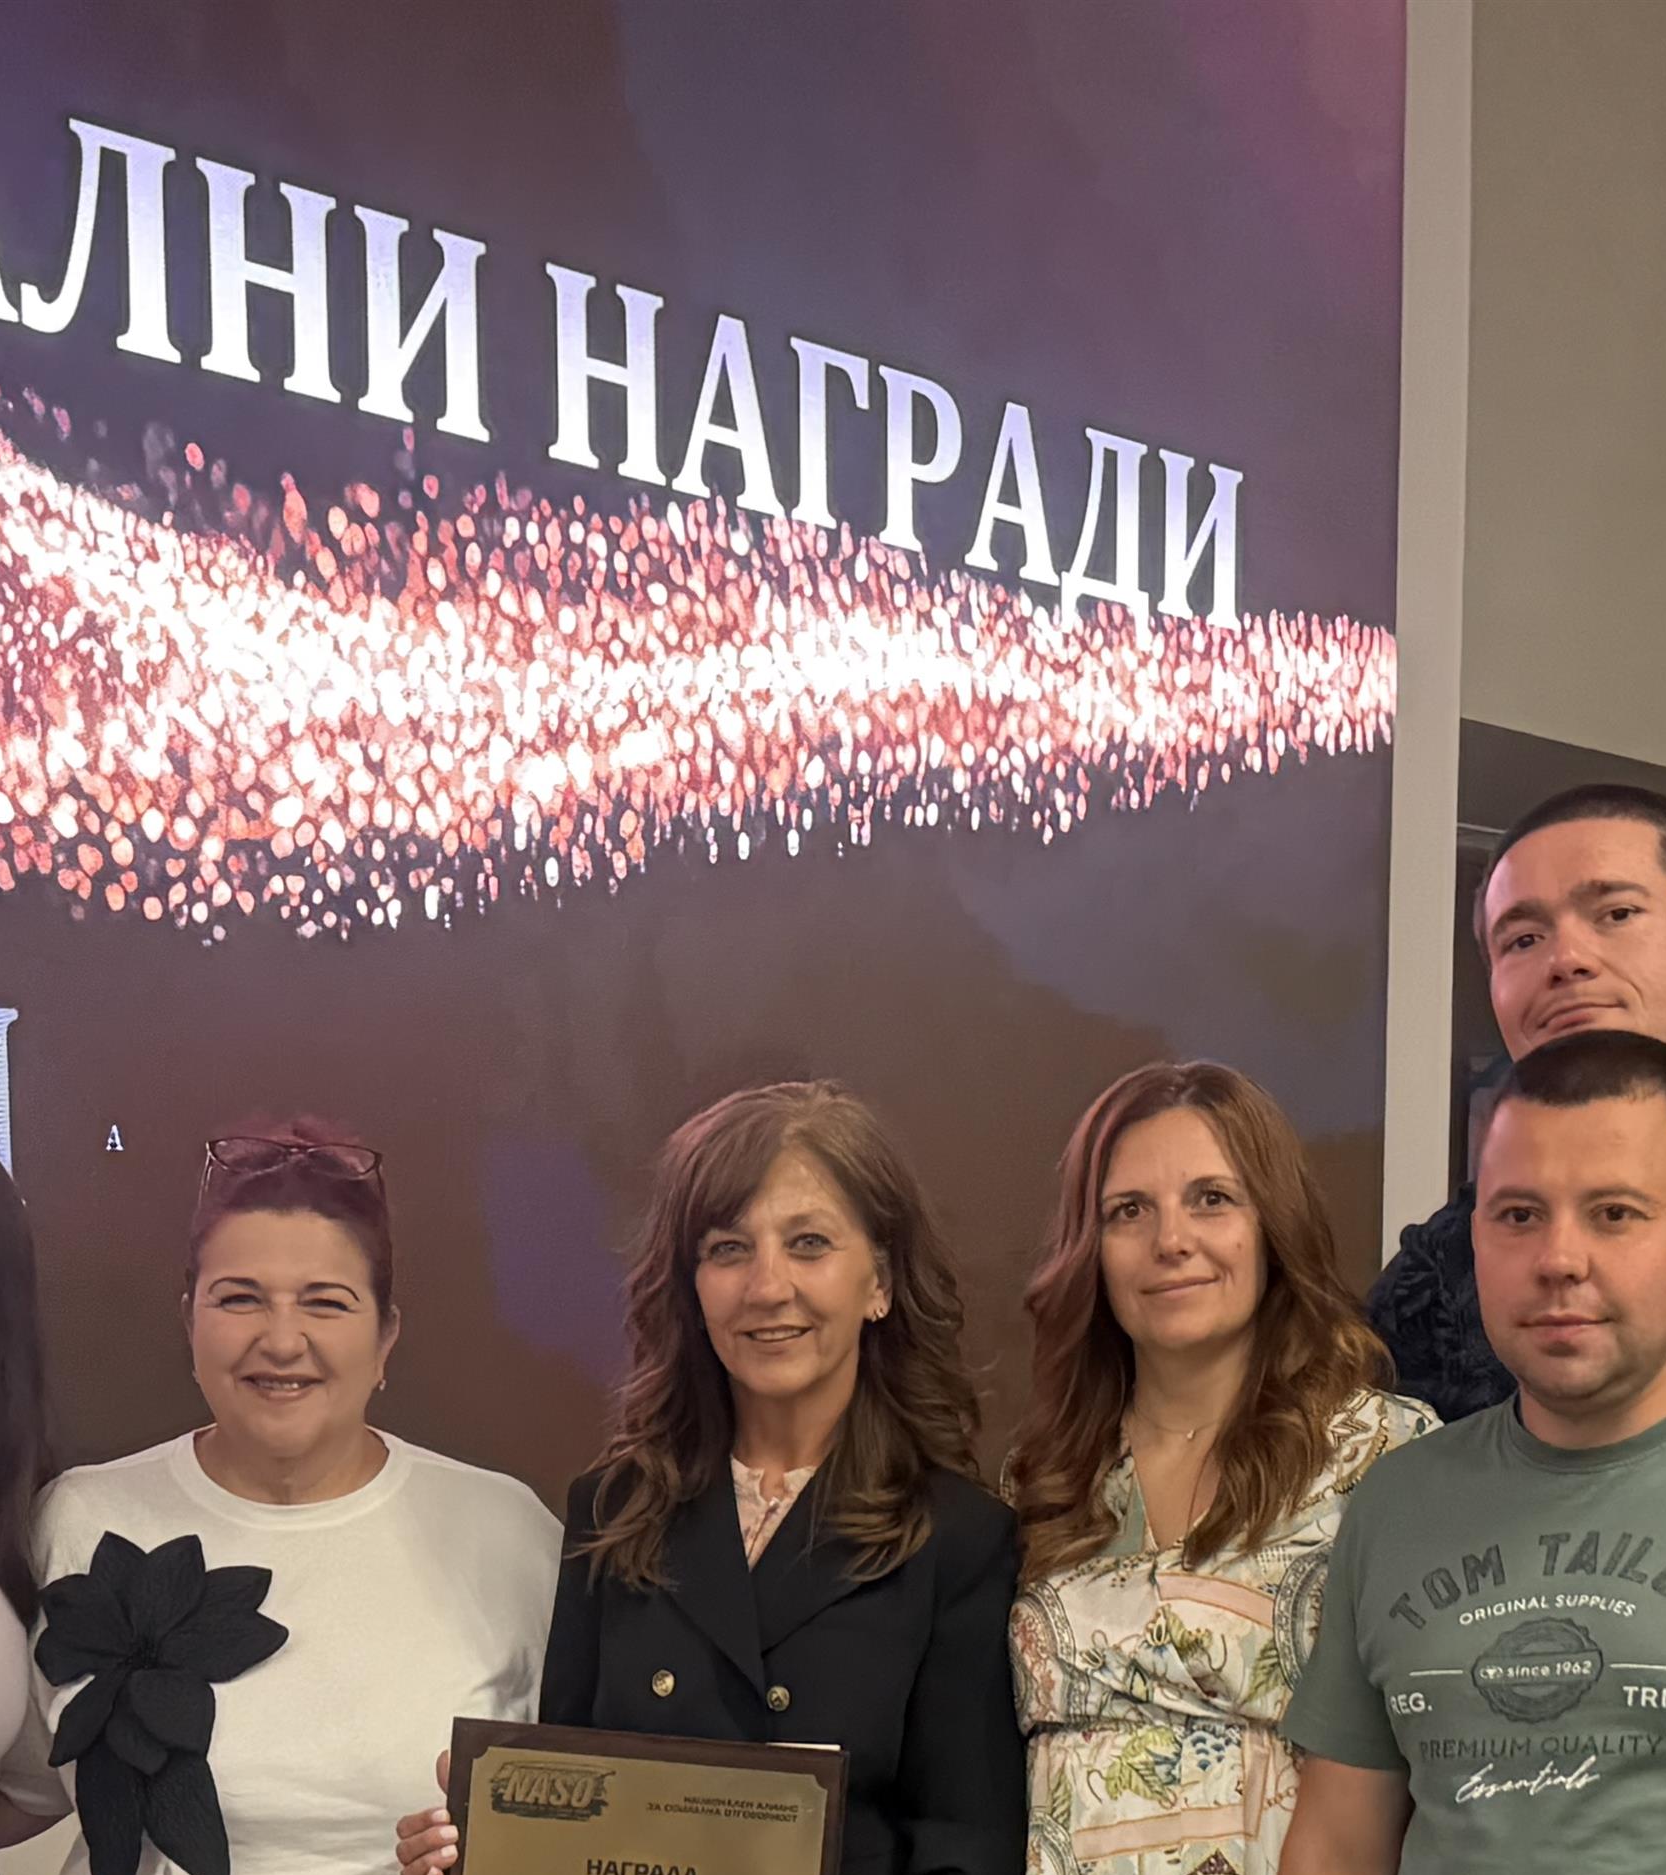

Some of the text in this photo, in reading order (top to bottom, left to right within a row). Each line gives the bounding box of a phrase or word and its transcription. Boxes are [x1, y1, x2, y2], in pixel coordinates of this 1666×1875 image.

[545, 262, 1244, 645] НАГРАДИ
[1388, 1543, 1507, 1630] TOM
[1459, 1594, 1637, 1625] ORIGINAL SUPPLIES
[1506, 1660, 1592, 1678] since 1962
[1389, 1691, 1433, 1715] REG.
[1419, 1734, 1664, 1761] PREMIUM QUALITY
[502, 1768, 595, 1809] NASO
[1455, 1754, 1601, 1804] Essentials
